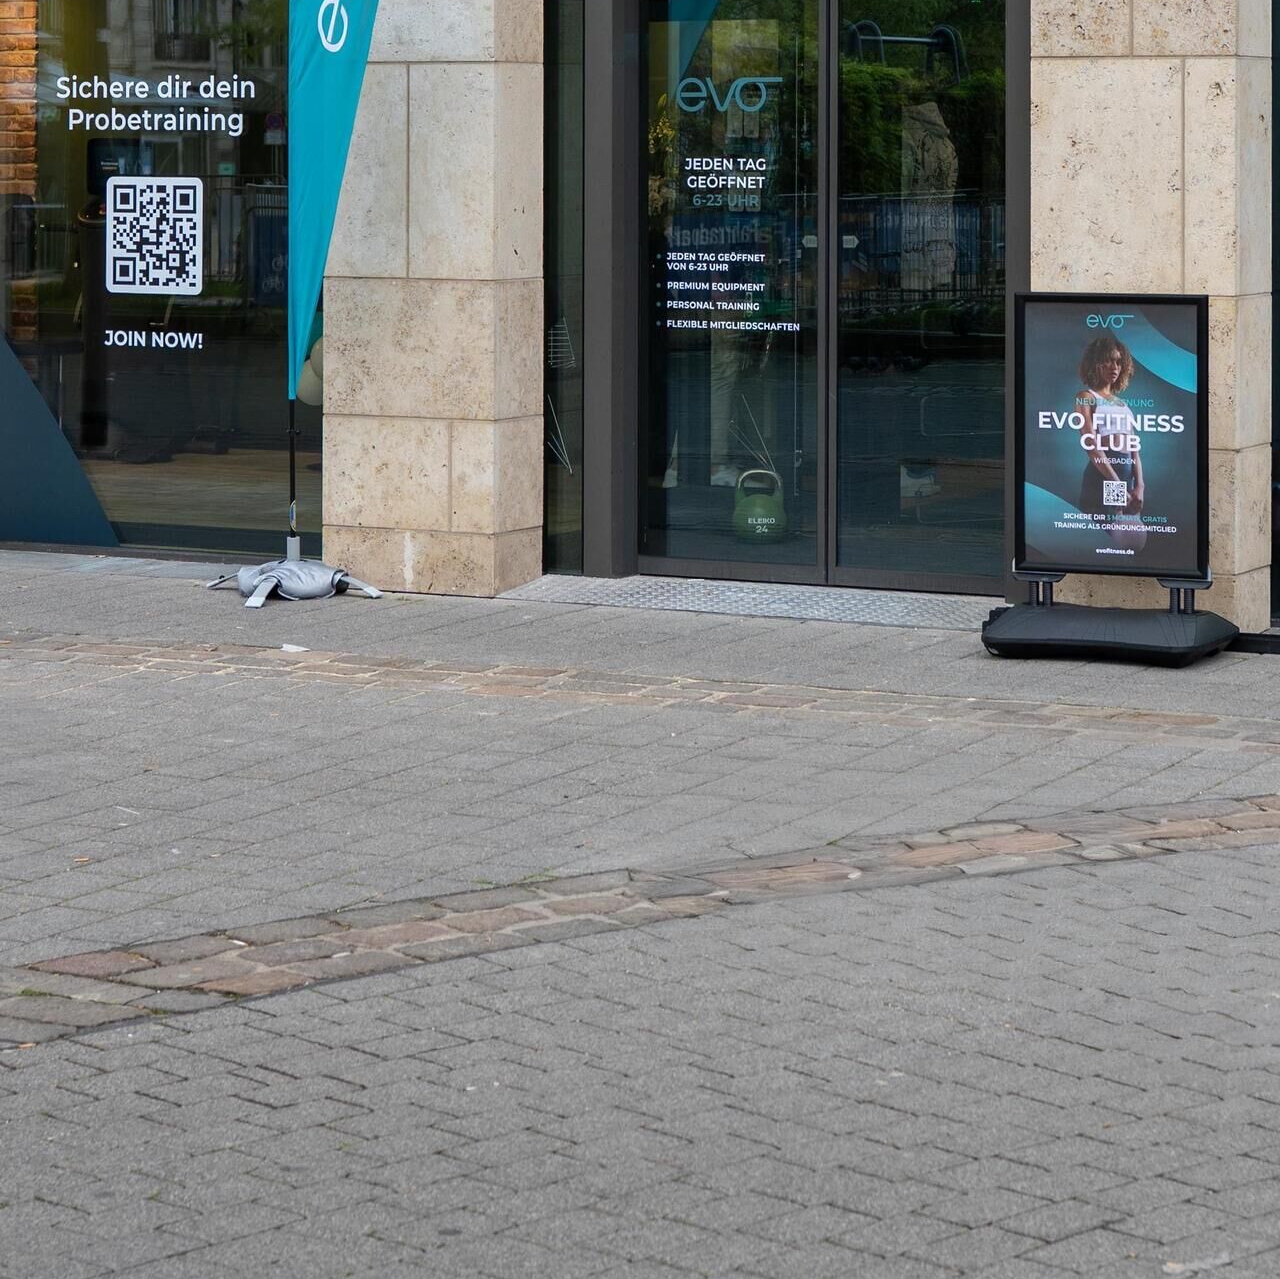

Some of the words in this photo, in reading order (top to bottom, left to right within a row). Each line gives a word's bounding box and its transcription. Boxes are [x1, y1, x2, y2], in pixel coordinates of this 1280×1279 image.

[56, 75, 150, 99] Sichere
[157, 75, 192, 99] dir
[199, 74, 256, 99] dein
[676, 77, 783, 113] evo
[68, 107, 244, 137] Probetraining
[685, 158, 733, 171] JEDEN
[737, 158, 766, 171] TAG
[687, 174, 766, 189] GEÖFFNET
[693, 194, 723, 206] 6-23
[727, 194, 760, 207] UHR
[666, 253, 696, 261] JEDEN
[698, 253, 716, 262] TAG
[717, 251, 766, 262] GEÖFFNET
[667, 263, 687, 271] VON
[688, 263, 707, 271] 6-23
[709, 263, 729, 272] UHR
[667, 282, 710, 290] PREMIUM
[711, 282, 766, 292] EQUIPMENT
[666, 301, 714, 310] PERSONAL
[716, 302, 760, 311] TRAINING
[666, 320, 708, 329] FLEXIBLE
[710, 321, 801, 331] MITGLIEDSCHAFTEN
[1086, 314, 1135, 329] evo
[104, 330, 148, 348] JOIN
[151, 331, 203, 349] NOW!
[1075, 397, 1154, 407] NEUENUNG
[1038, 412, 1086, 430] EVO
[1092, 413, 1185, 433] FITNESS
[1080, 433, 1142, 452] CLUB
[1094, 457, 1136, 465] WIESBADEN
[1063, 513, 1092, 521] SICHERE
[755, 525, 768, 533] 24
[1054, 522, 1086, 530] TRAINING
[1101, 523, 1177, 534] GRÜNDUNGSMITGLIED
